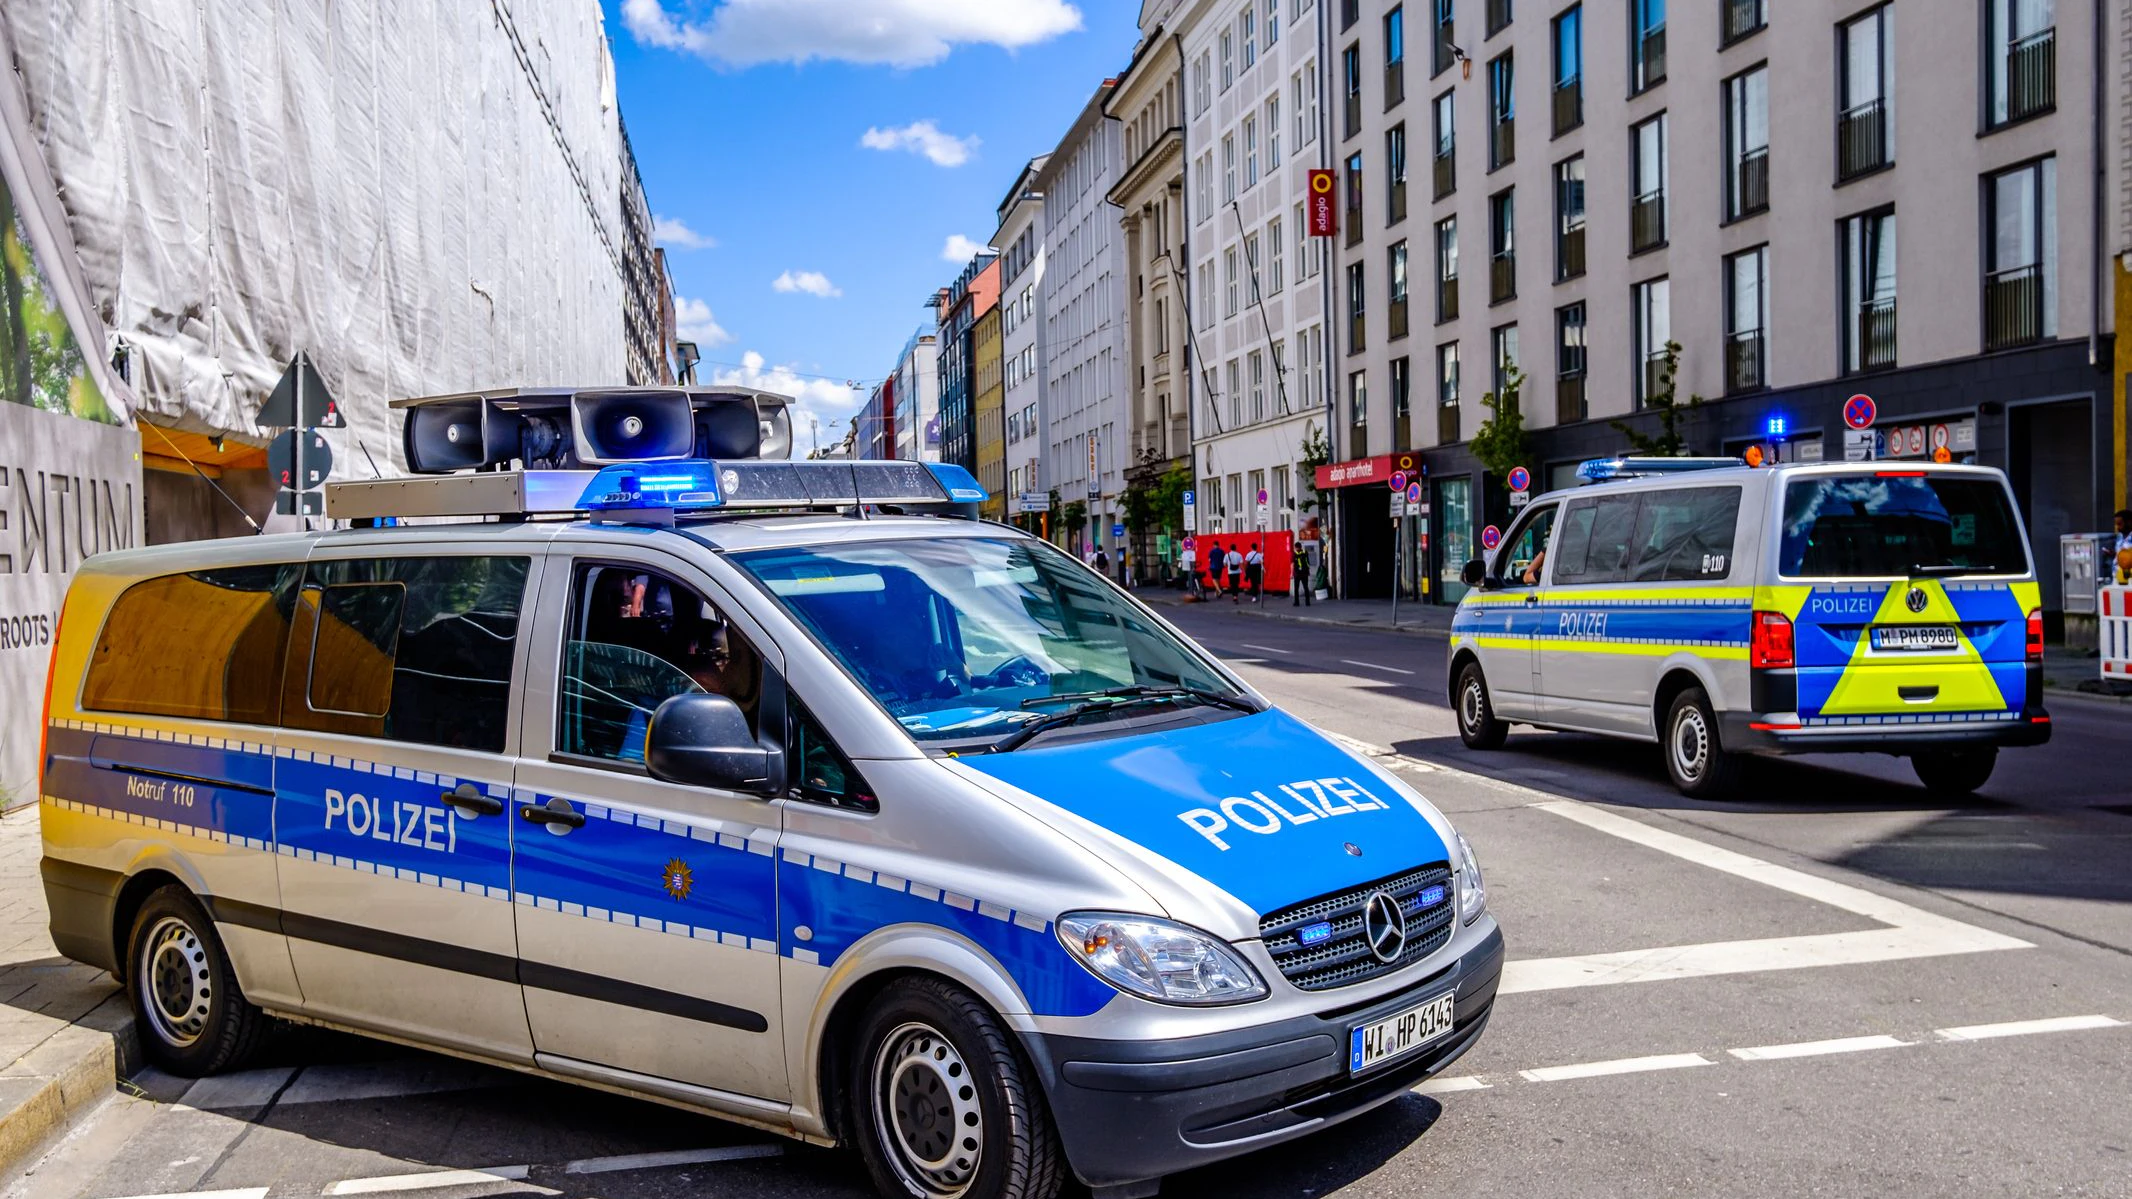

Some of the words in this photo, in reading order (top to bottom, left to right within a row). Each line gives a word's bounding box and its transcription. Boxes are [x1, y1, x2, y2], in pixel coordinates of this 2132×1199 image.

[1316, 197, 1328, 231] adagio
[1330, 465, 1345, 485] adagio
[1346, 459, 1373, 483] aparthotel
[1184, 493, 1191, 504] P
[1711, 555, 1725, 572] 110
[1812, 598, 1872, 613] POLIZEI
[0, 614, 49, 650] ROOTS
[1559, 612, 1608, 636] POLIZEI
[1880, 629, 1891, 644] M
[1900, 629, 1919, 644] PM
[1920, 628, 1955, 644] 8980
[127, 775, 167, 801] Notruf
[172, 784, 194, 807] 110
[324, 788, 456, 854] POLIZEI
[1176, 776, 1391, 852] POLIZEI
[1364, 1025, 1383, 1061] WI
[1396, 1012, 1416, 1049] HP
[1419, 995, 1453, 1038] 6143
